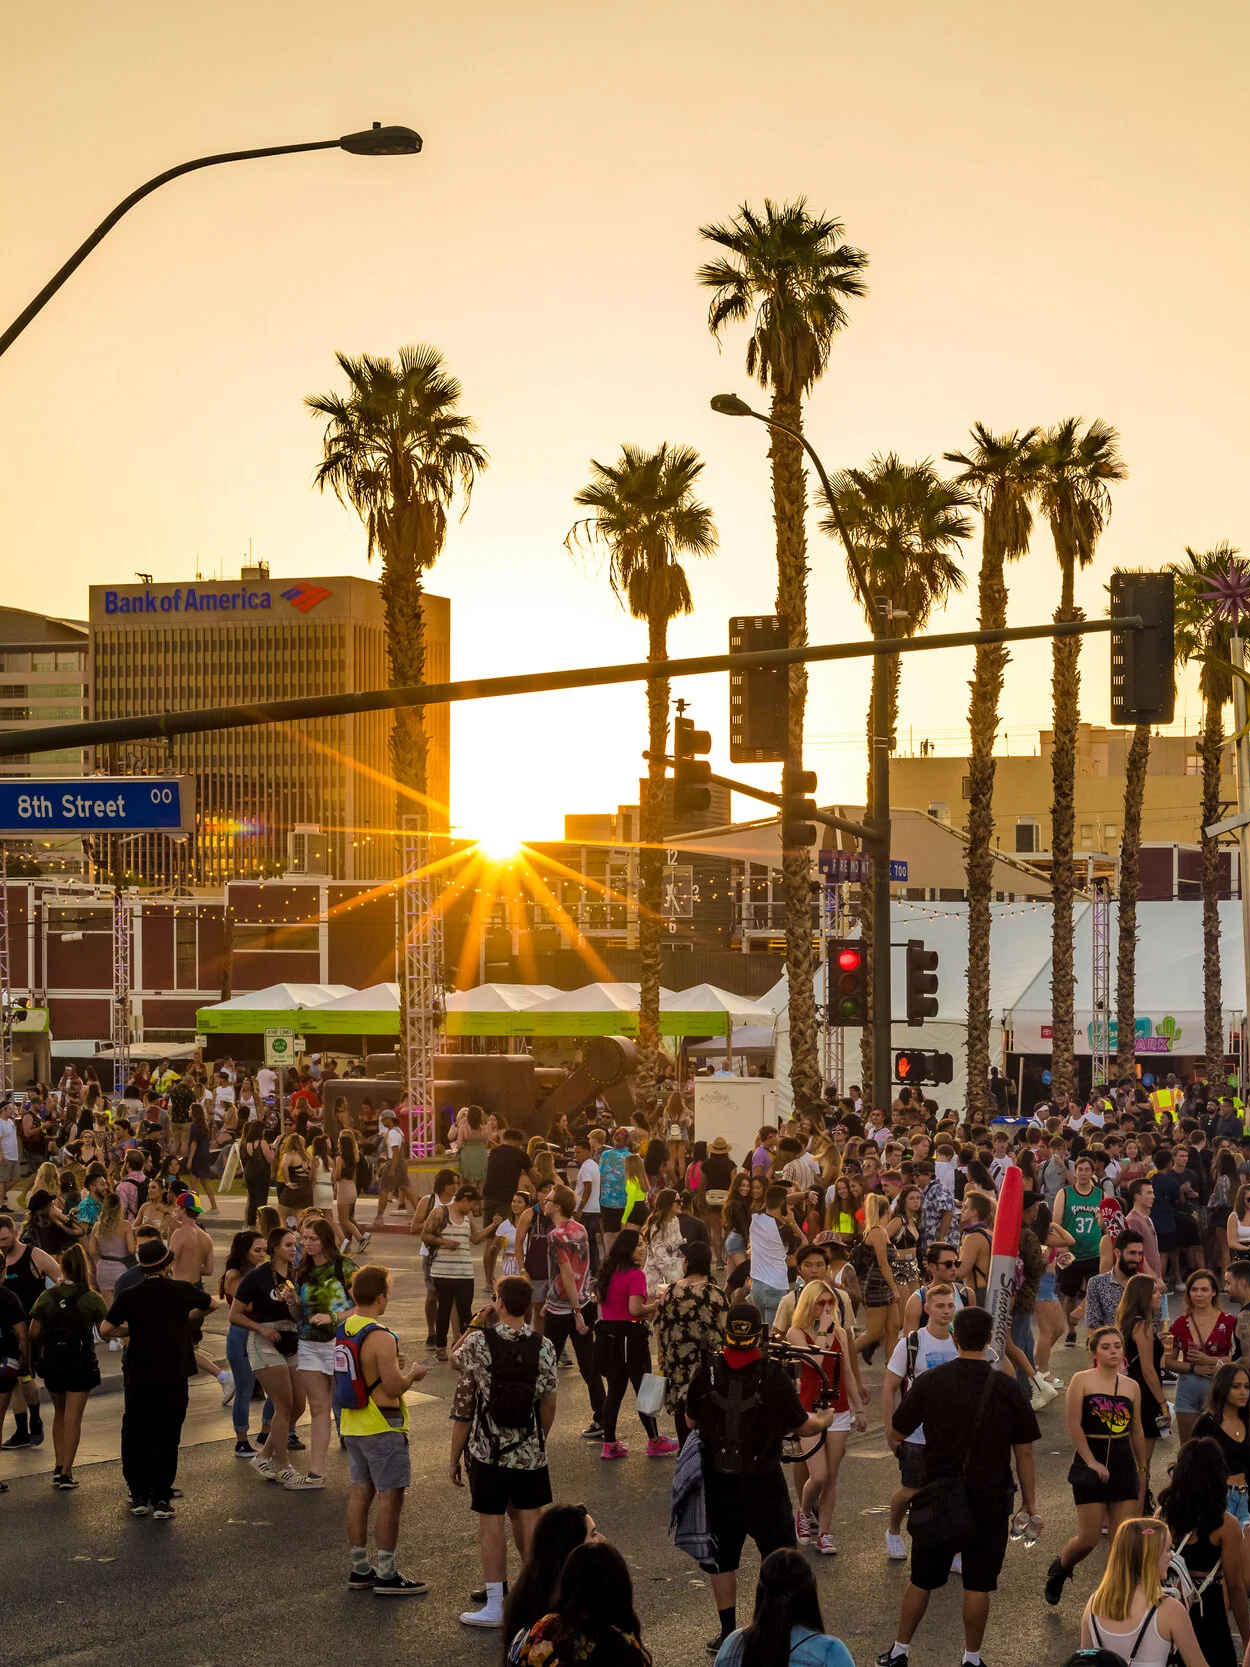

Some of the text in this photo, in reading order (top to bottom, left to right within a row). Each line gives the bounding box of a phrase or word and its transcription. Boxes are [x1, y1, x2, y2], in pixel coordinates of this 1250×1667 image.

[104, 587, 273, 614] Bank of America
[17, 788, 173, 819] 8th Street 00
[665, 849, 678, 866] 12
[1134, 1038, 1168, 1051] ARK
[1075, 1217, 1095, 1234] 37
